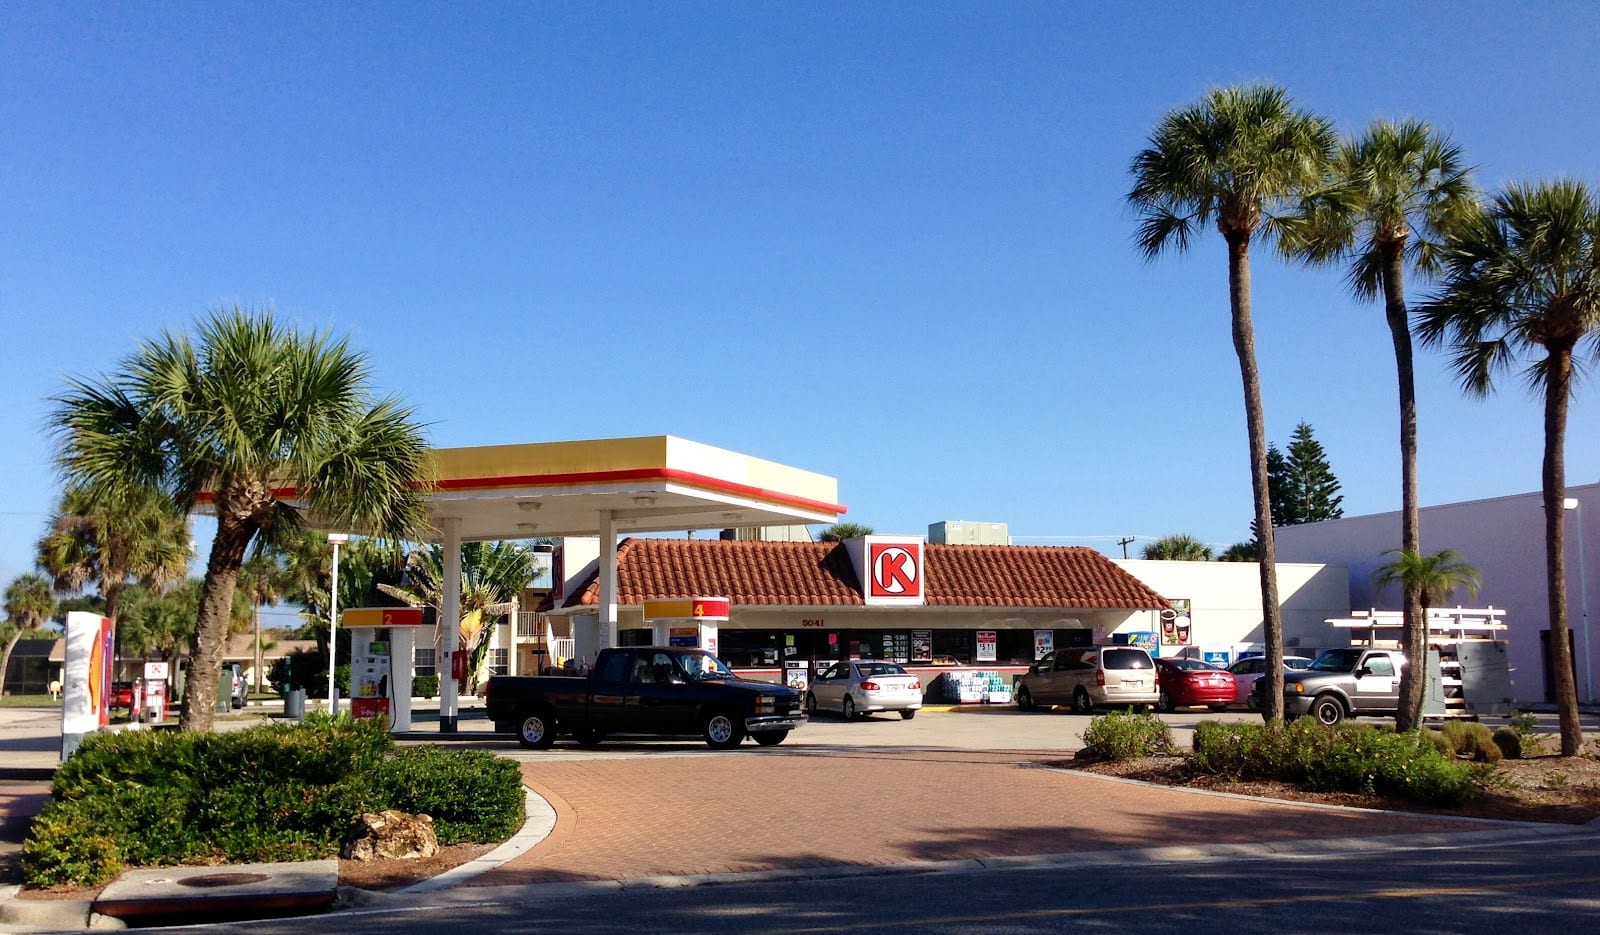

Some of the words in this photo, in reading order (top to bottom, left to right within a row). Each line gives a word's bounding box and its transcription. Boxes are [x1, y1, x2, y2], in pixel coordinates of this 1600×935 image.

[881, 552, 914, 592] K
[694, 604, 704, 616] 4
[384, 613, 393, 625] 2
[802, 619, 824, 627] 5041
